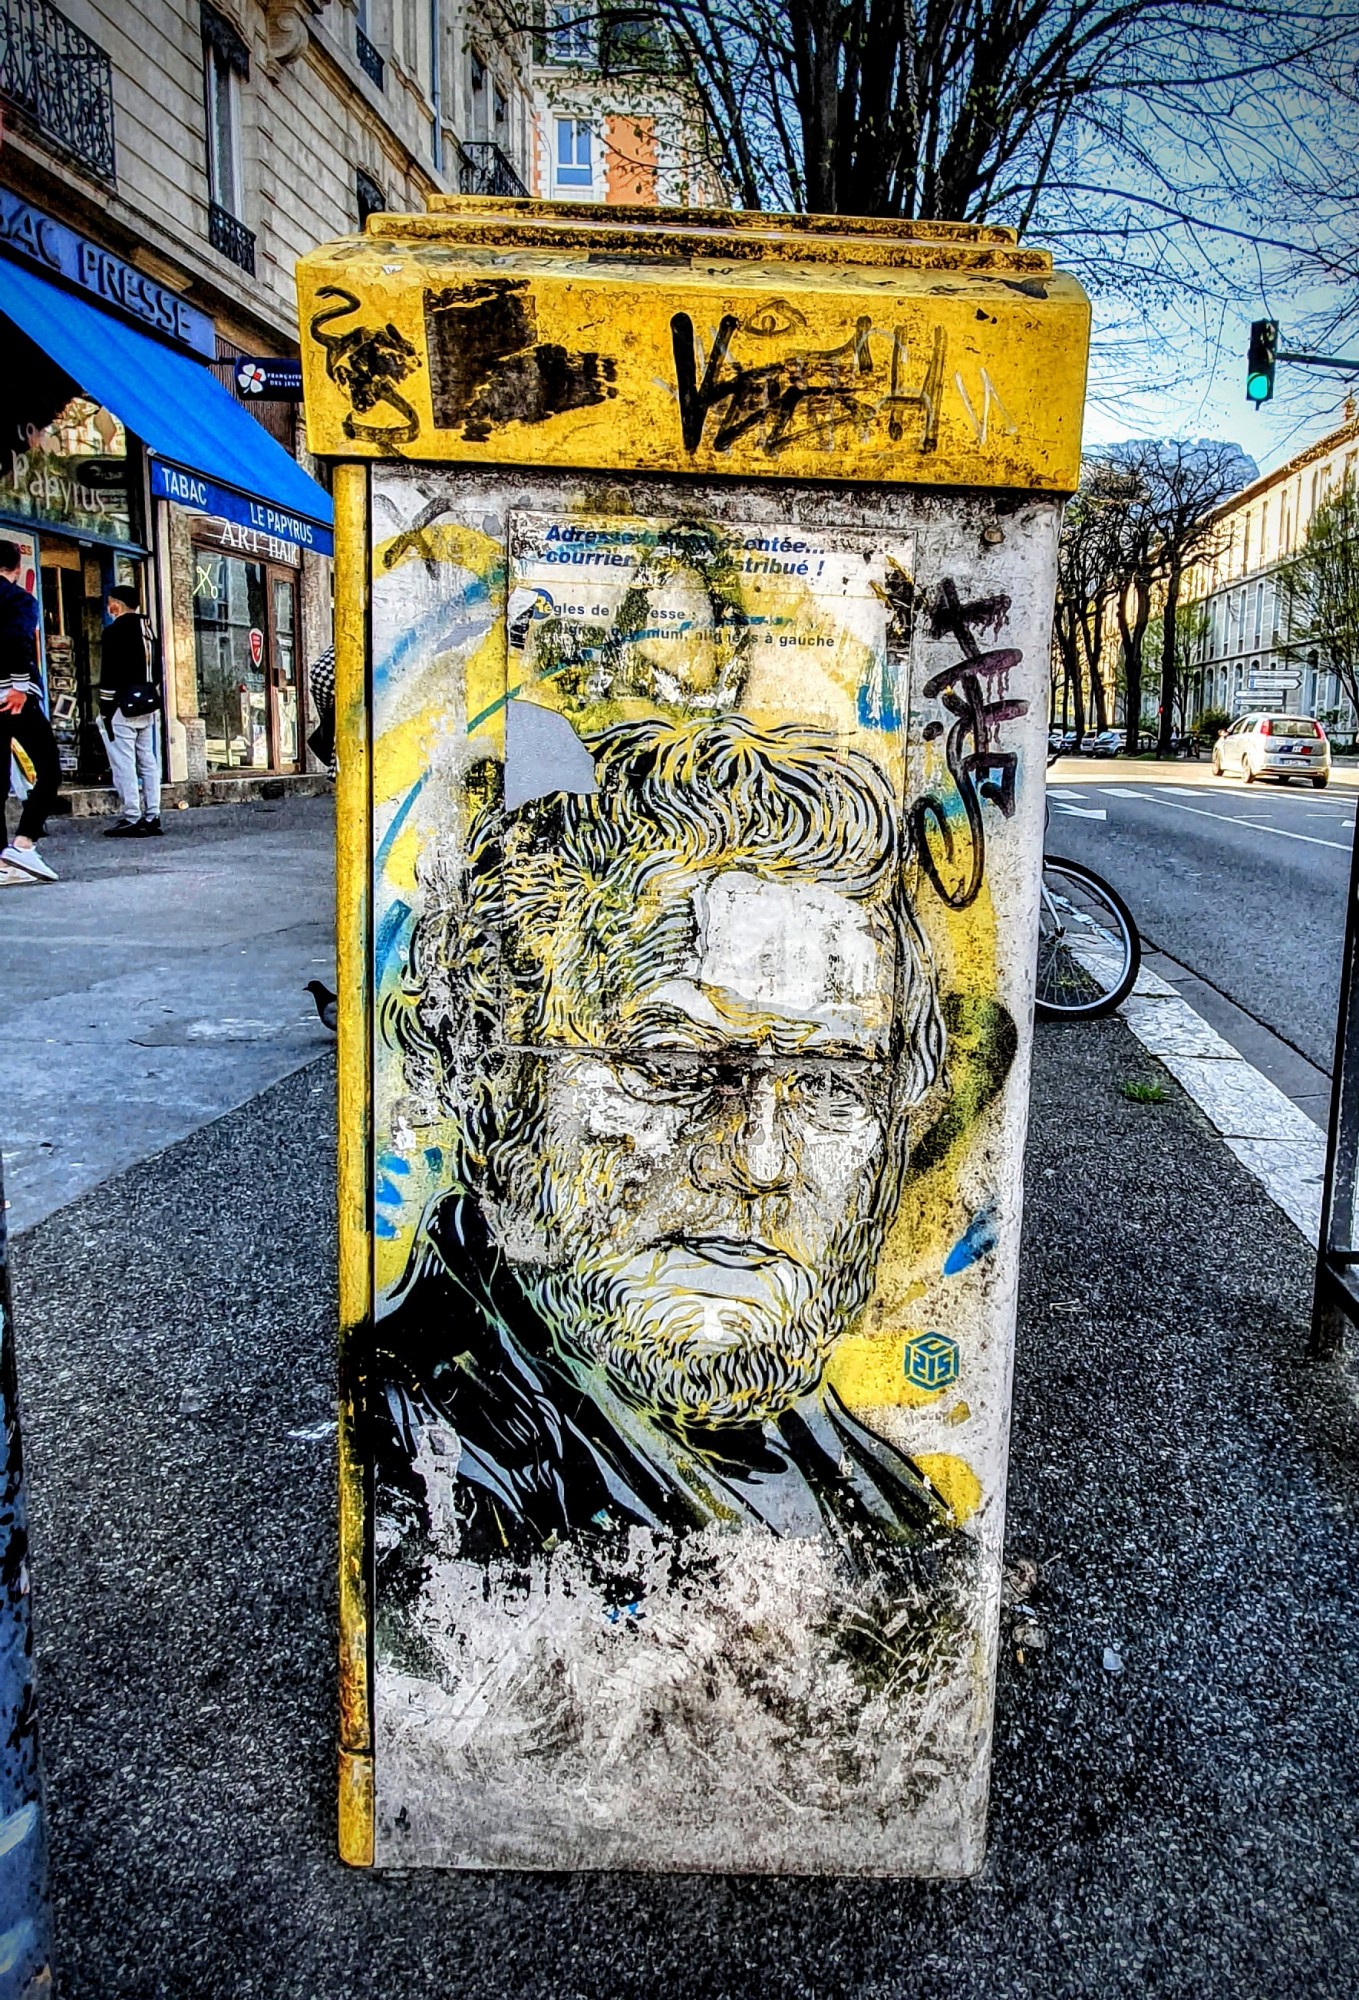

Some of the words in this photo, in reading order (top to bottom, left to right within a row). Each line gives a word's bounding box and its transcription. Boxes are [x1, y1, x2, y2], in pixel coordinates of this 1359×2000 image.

[77, 240, 191, 343] PRESSE
[162, 467, 207, 506] TABAC
[220, 521, 258, 553] ART
[268, 536, 298, 565] HAIR
[250, 502, 265, 528] LE
[267, 512, 313, 545] PAPYRUS
[546, 550, 633, 568] courrier
[591, 604, 610, 616] de
[764, 632, 773, 644] à
[779, 632, 835, 647] gauche
